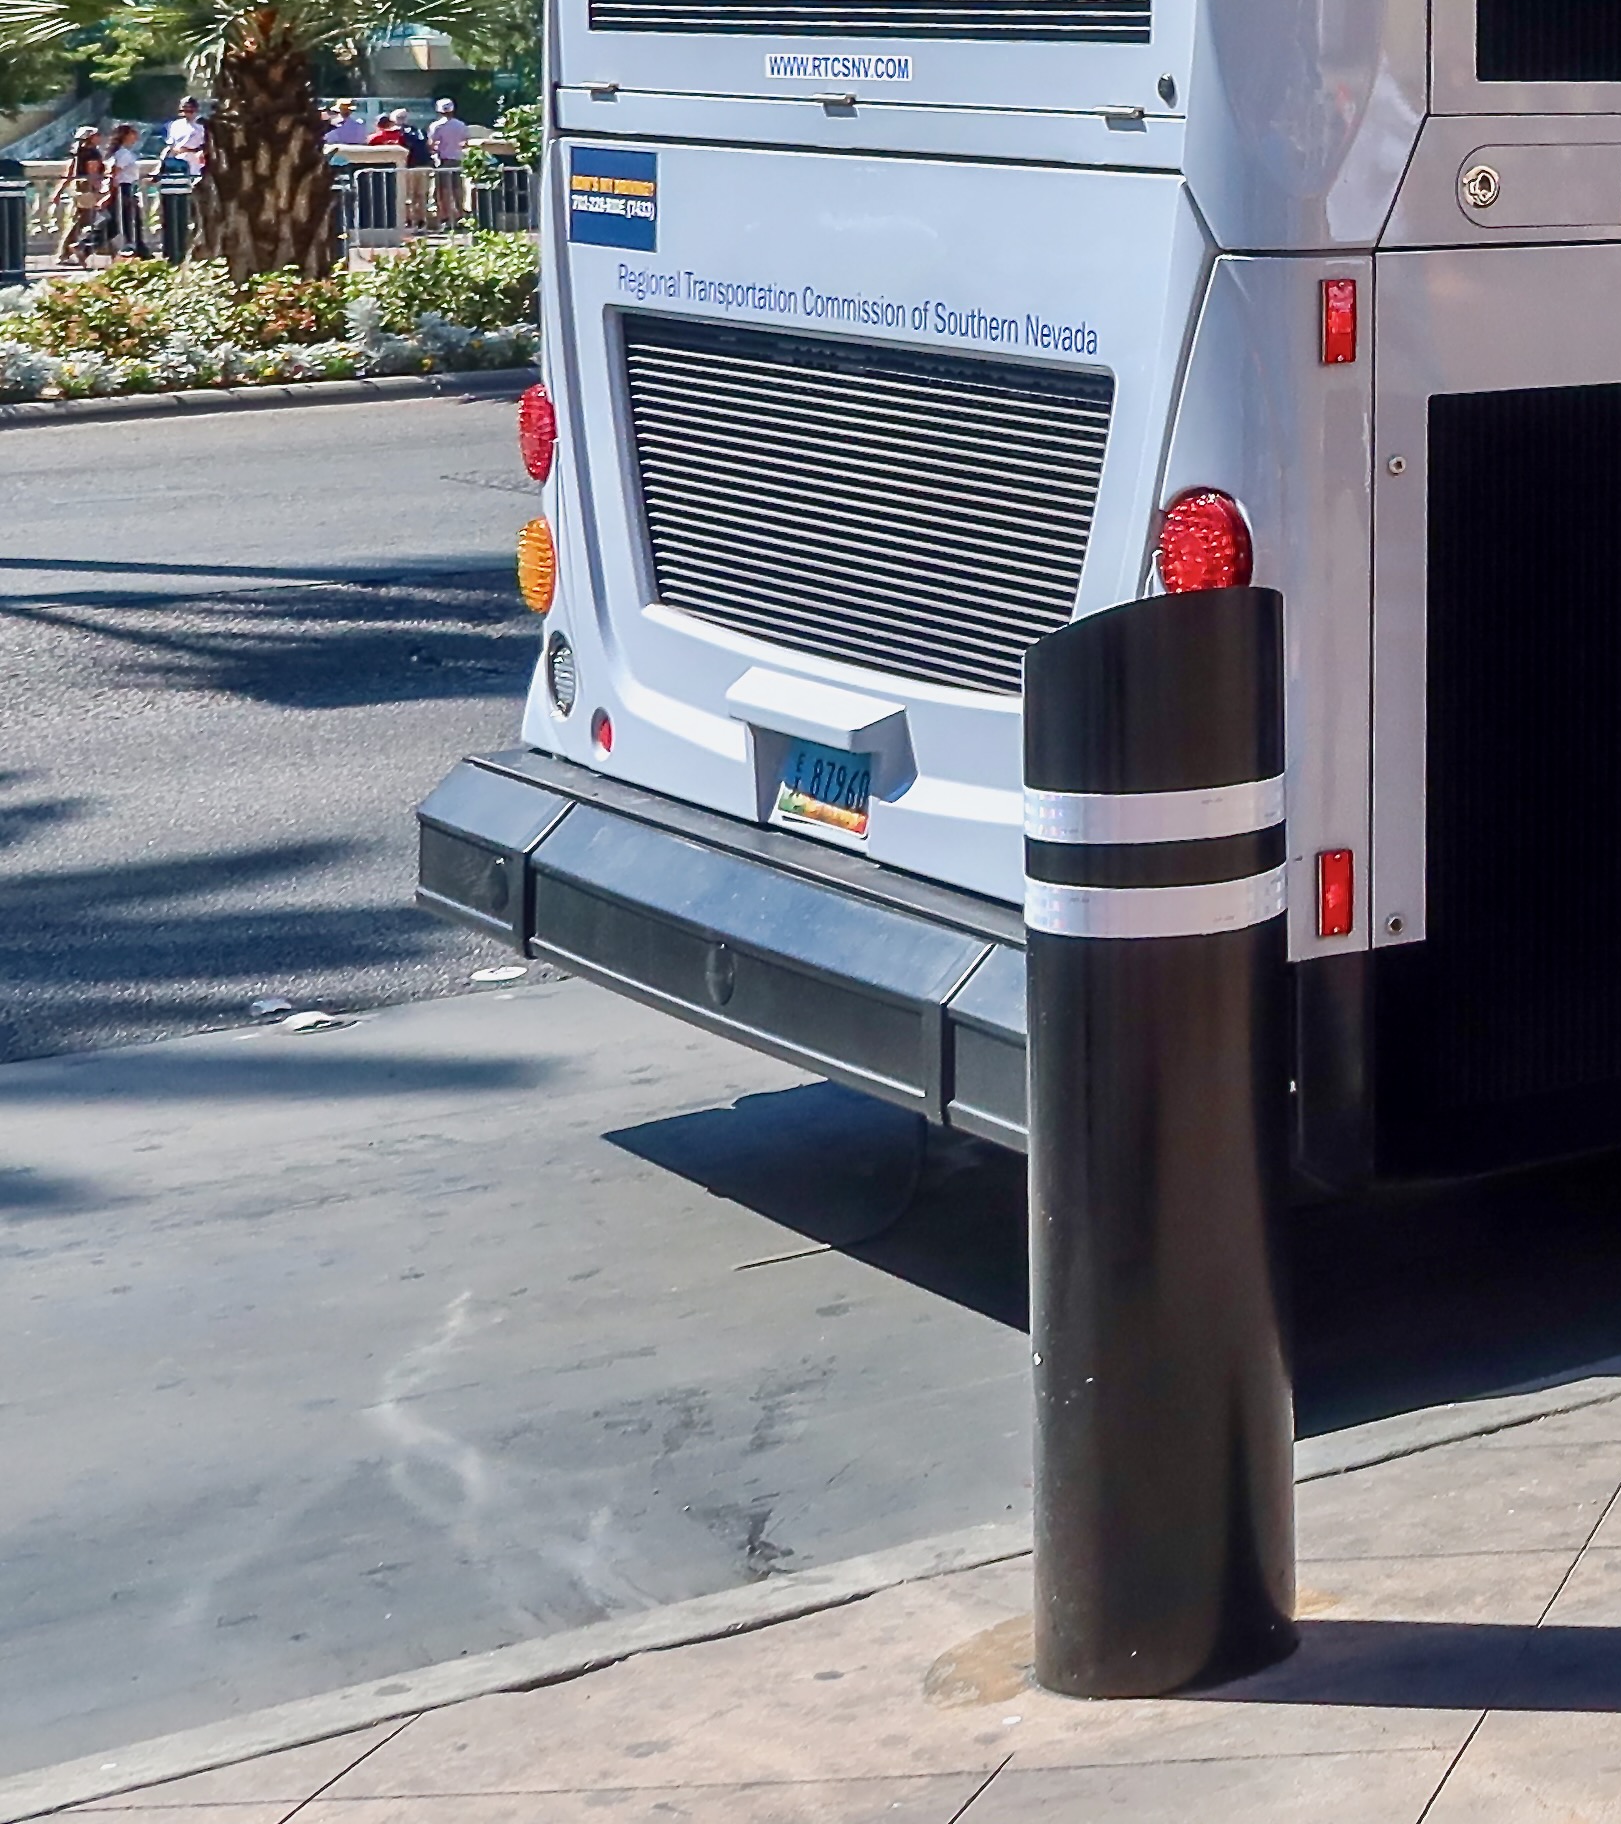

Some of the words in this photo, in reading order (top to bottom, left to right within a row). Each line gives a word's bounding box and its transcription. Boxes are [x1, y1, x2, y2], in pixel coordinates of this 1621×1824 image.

[768, 55, 910, 80] WWW.RTCSNV.COM
[617, 263, 681, 302] Regional
[684, 271, 798, 314] Transportation
[802, 285, 906, 328] Commission
[911, 300, 931, 332] of
[933, 302, 1019, 344] Southern
[1024, 313, 1098, 356] Nevada
